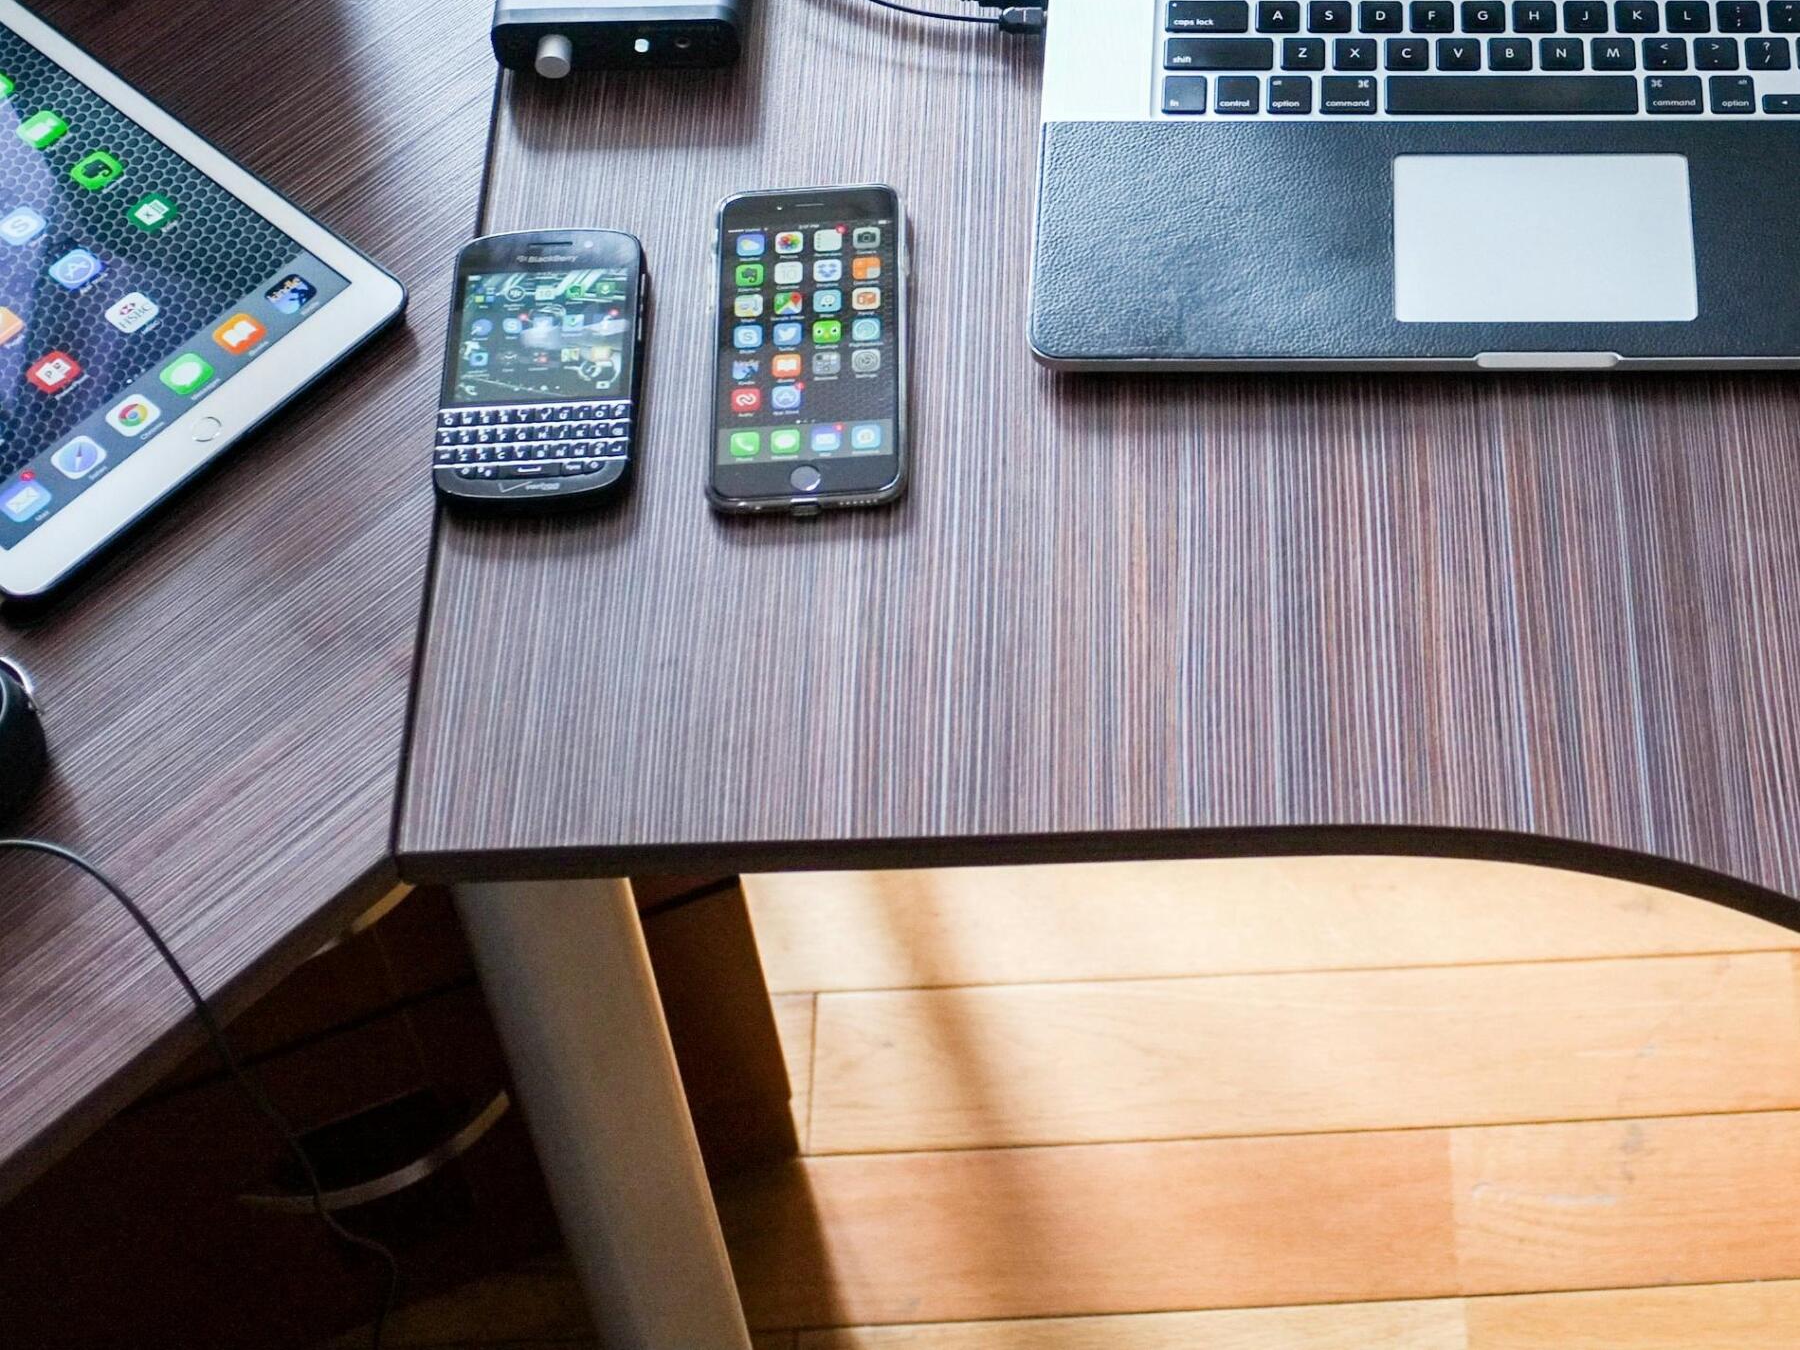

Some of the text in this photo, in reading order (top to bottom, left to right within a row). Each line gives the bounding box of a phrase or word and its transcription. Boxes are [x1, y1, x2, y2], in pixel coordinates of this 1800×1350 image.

[1273, 11, 1283, 20] A
[1325, 10, 1333, 20] S
[1376, 11, 1385, 20] D
[1428, 11, 1435, 20] F
[1478, 11, 1488, 20] G
[1529, 11, 1539, 20] H
[1583, 11, 1588, 20] J
[1633, 10, 1642, 19] K
[1684, 11, 1691, 20] L
[1298, 48, 1307, 57] Z
[1350, 49, 1359, 57] X
[1402, 48, 1411, 58] C
[1453, 48, 1463, 58] V
[1506, 48, 1514, 58] B
[1556, 48, 1566, 57] N
[1607, 48, 1620, 57] M
